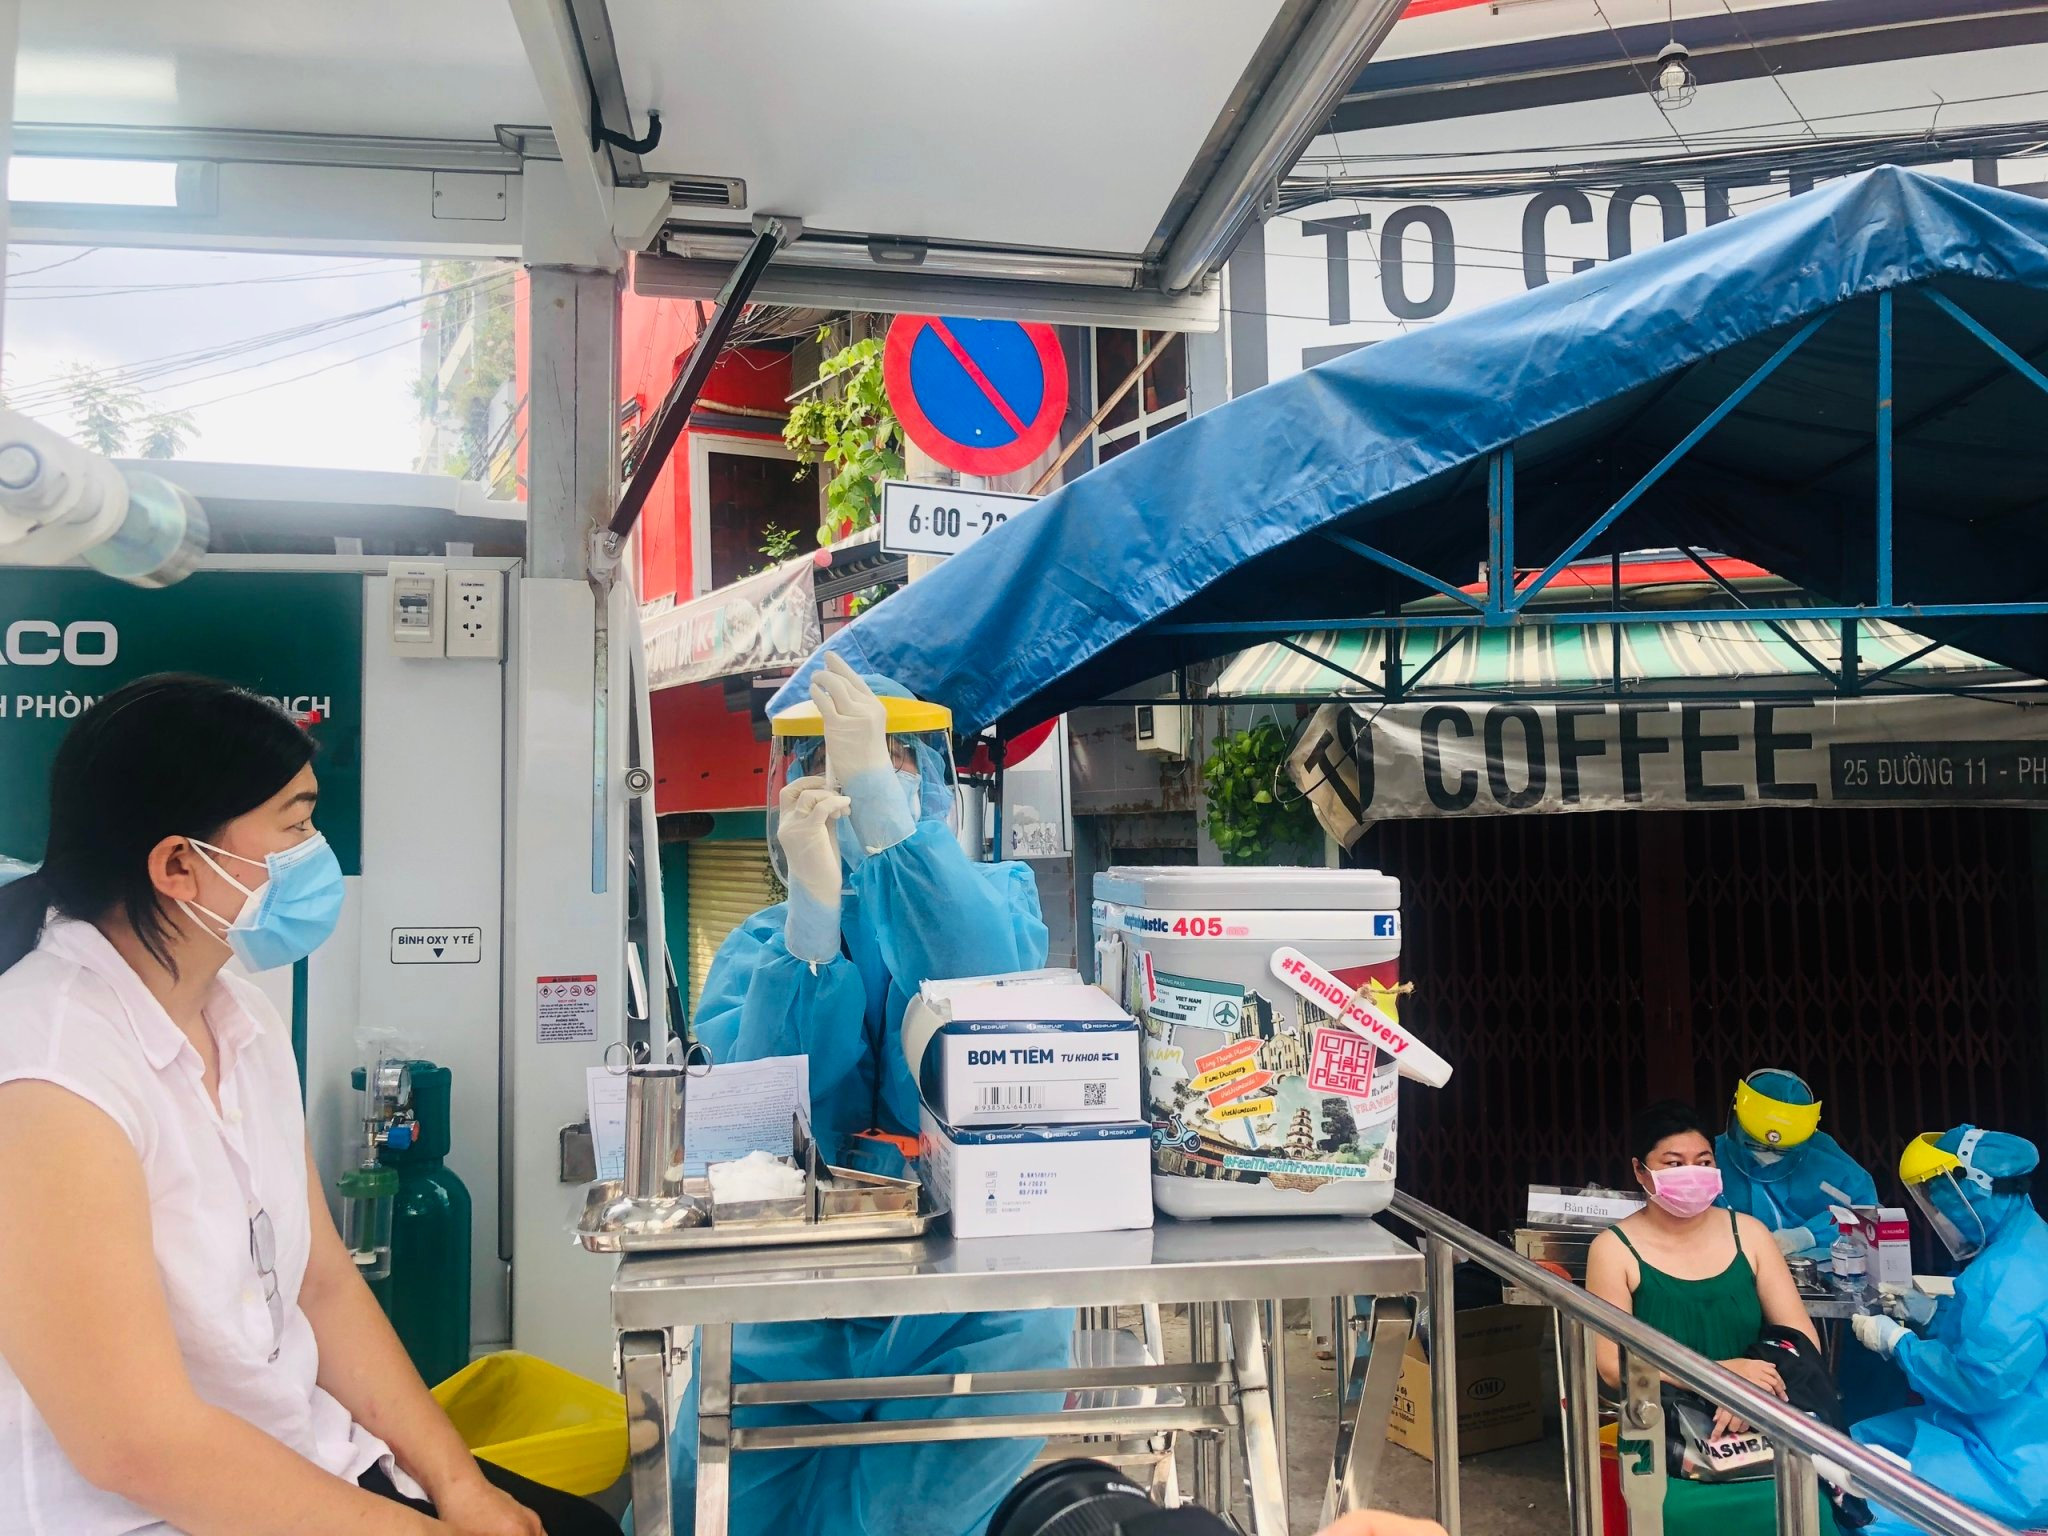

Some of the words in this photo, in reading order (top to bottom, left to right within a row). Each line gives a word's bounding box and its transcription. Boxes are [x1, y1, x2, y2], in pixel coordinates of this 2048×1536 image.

[1302, 205, 1456, 326] TO
[0, 620, 118, 666] CO
[1420, 699, 1818, 811] COFFEE
[1843, 759, 1868, 786] 25
[1878, 752, 1953, 785] ĐƯỜNG
[1964, 757, 1986, 785] 11
[398, 934, 425, 945] BÌNH
[426, 935, 449, 945] OXY
[453, 935, 460, 945] Y
[461, 932, 475, 944] TẾ
[1172, 917, 1223, 937] 405
[1282, 957, 1409, 1054] #FamiDiscovery
[1010, 1046, 1054, 1065] TIÊM
[1586, 1203, 1608, 1216] tiêm
